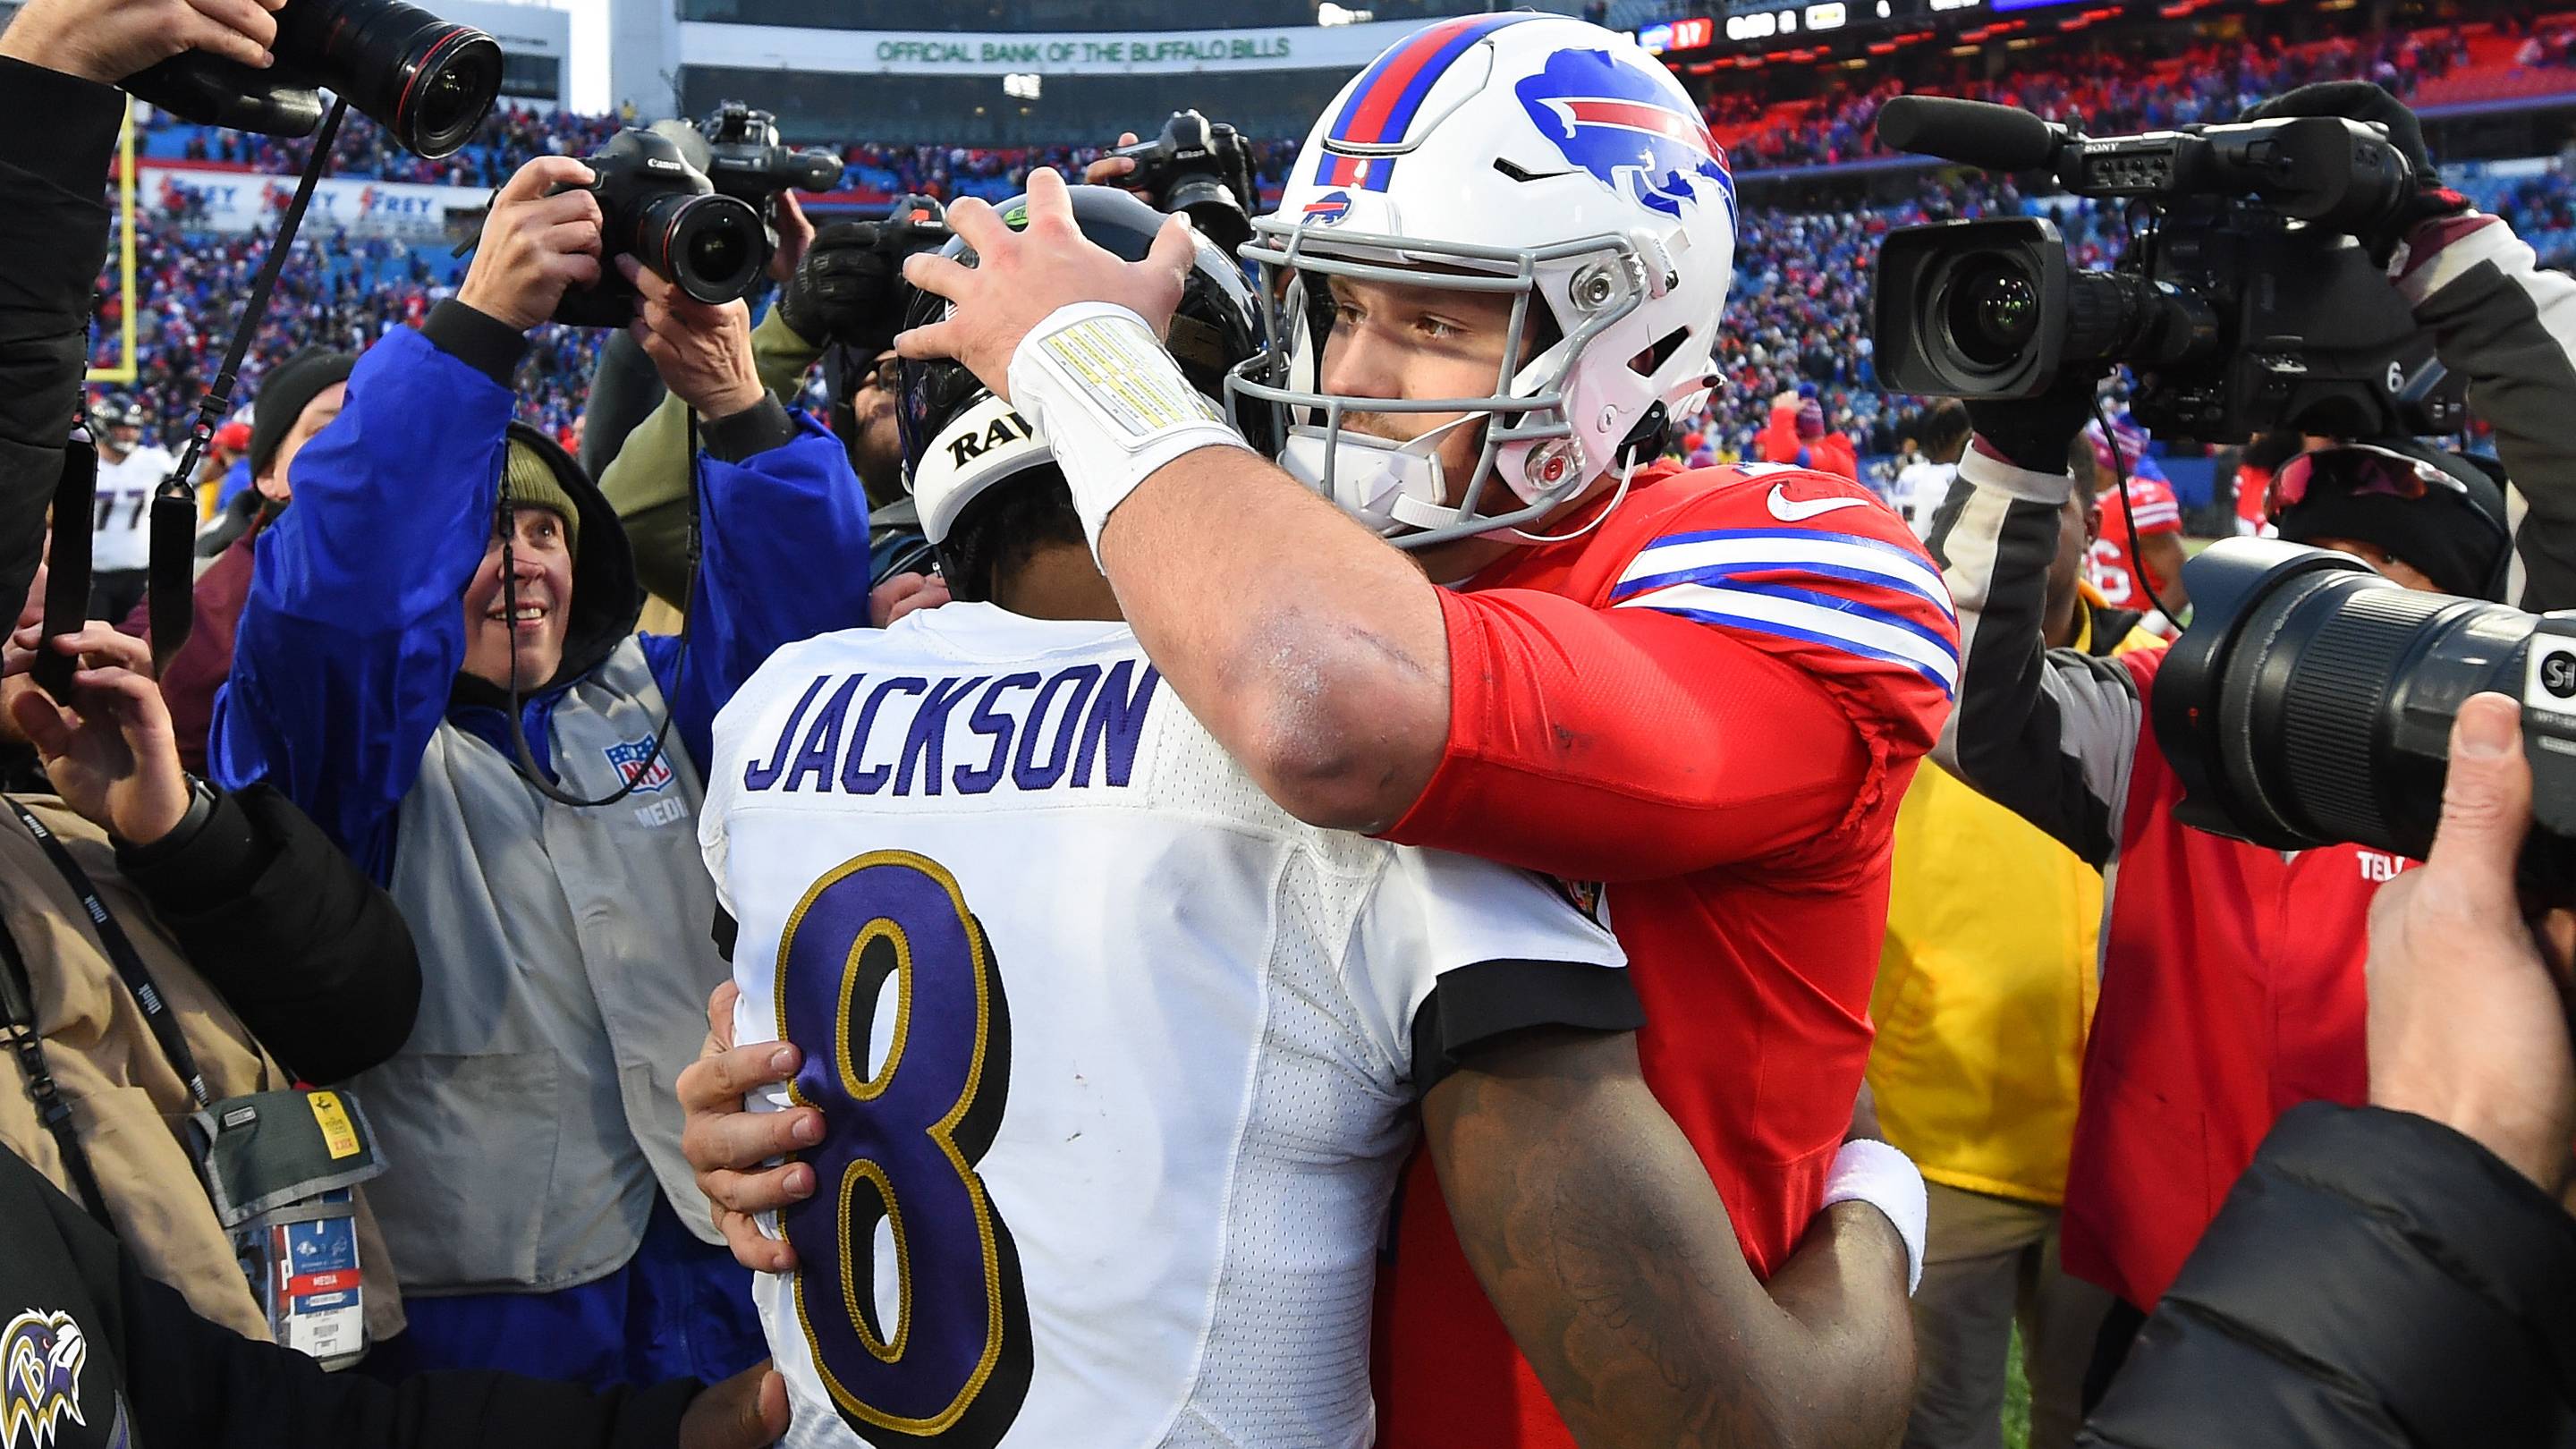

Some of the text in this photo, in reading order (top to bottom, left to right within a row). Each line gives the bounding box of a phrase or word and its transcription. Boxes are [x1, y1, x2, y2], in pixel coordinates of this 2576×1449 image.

[877, 37, 1291, 63] OFFICIAL BANK OF THE BUFFALO BILLS
[648, 157, 681, 170] Canon
[2084, 143, 2119, 153] SONY
[371, 190, 432, 213] FREY
[2387, 361, 2405, 393] 6
[945, 411, 1034, 472] RAV
[95, 488, 146, 532] 77
[2081, 538, 2131, 604] 6
[744, 659, 1161, 796] JACKSON
[634, 796, 689, 828] MEDI
[85, 894, 107, 923] think
[138, 983, 162, 1014] think
[775, 849, 1035, 1449] 8
